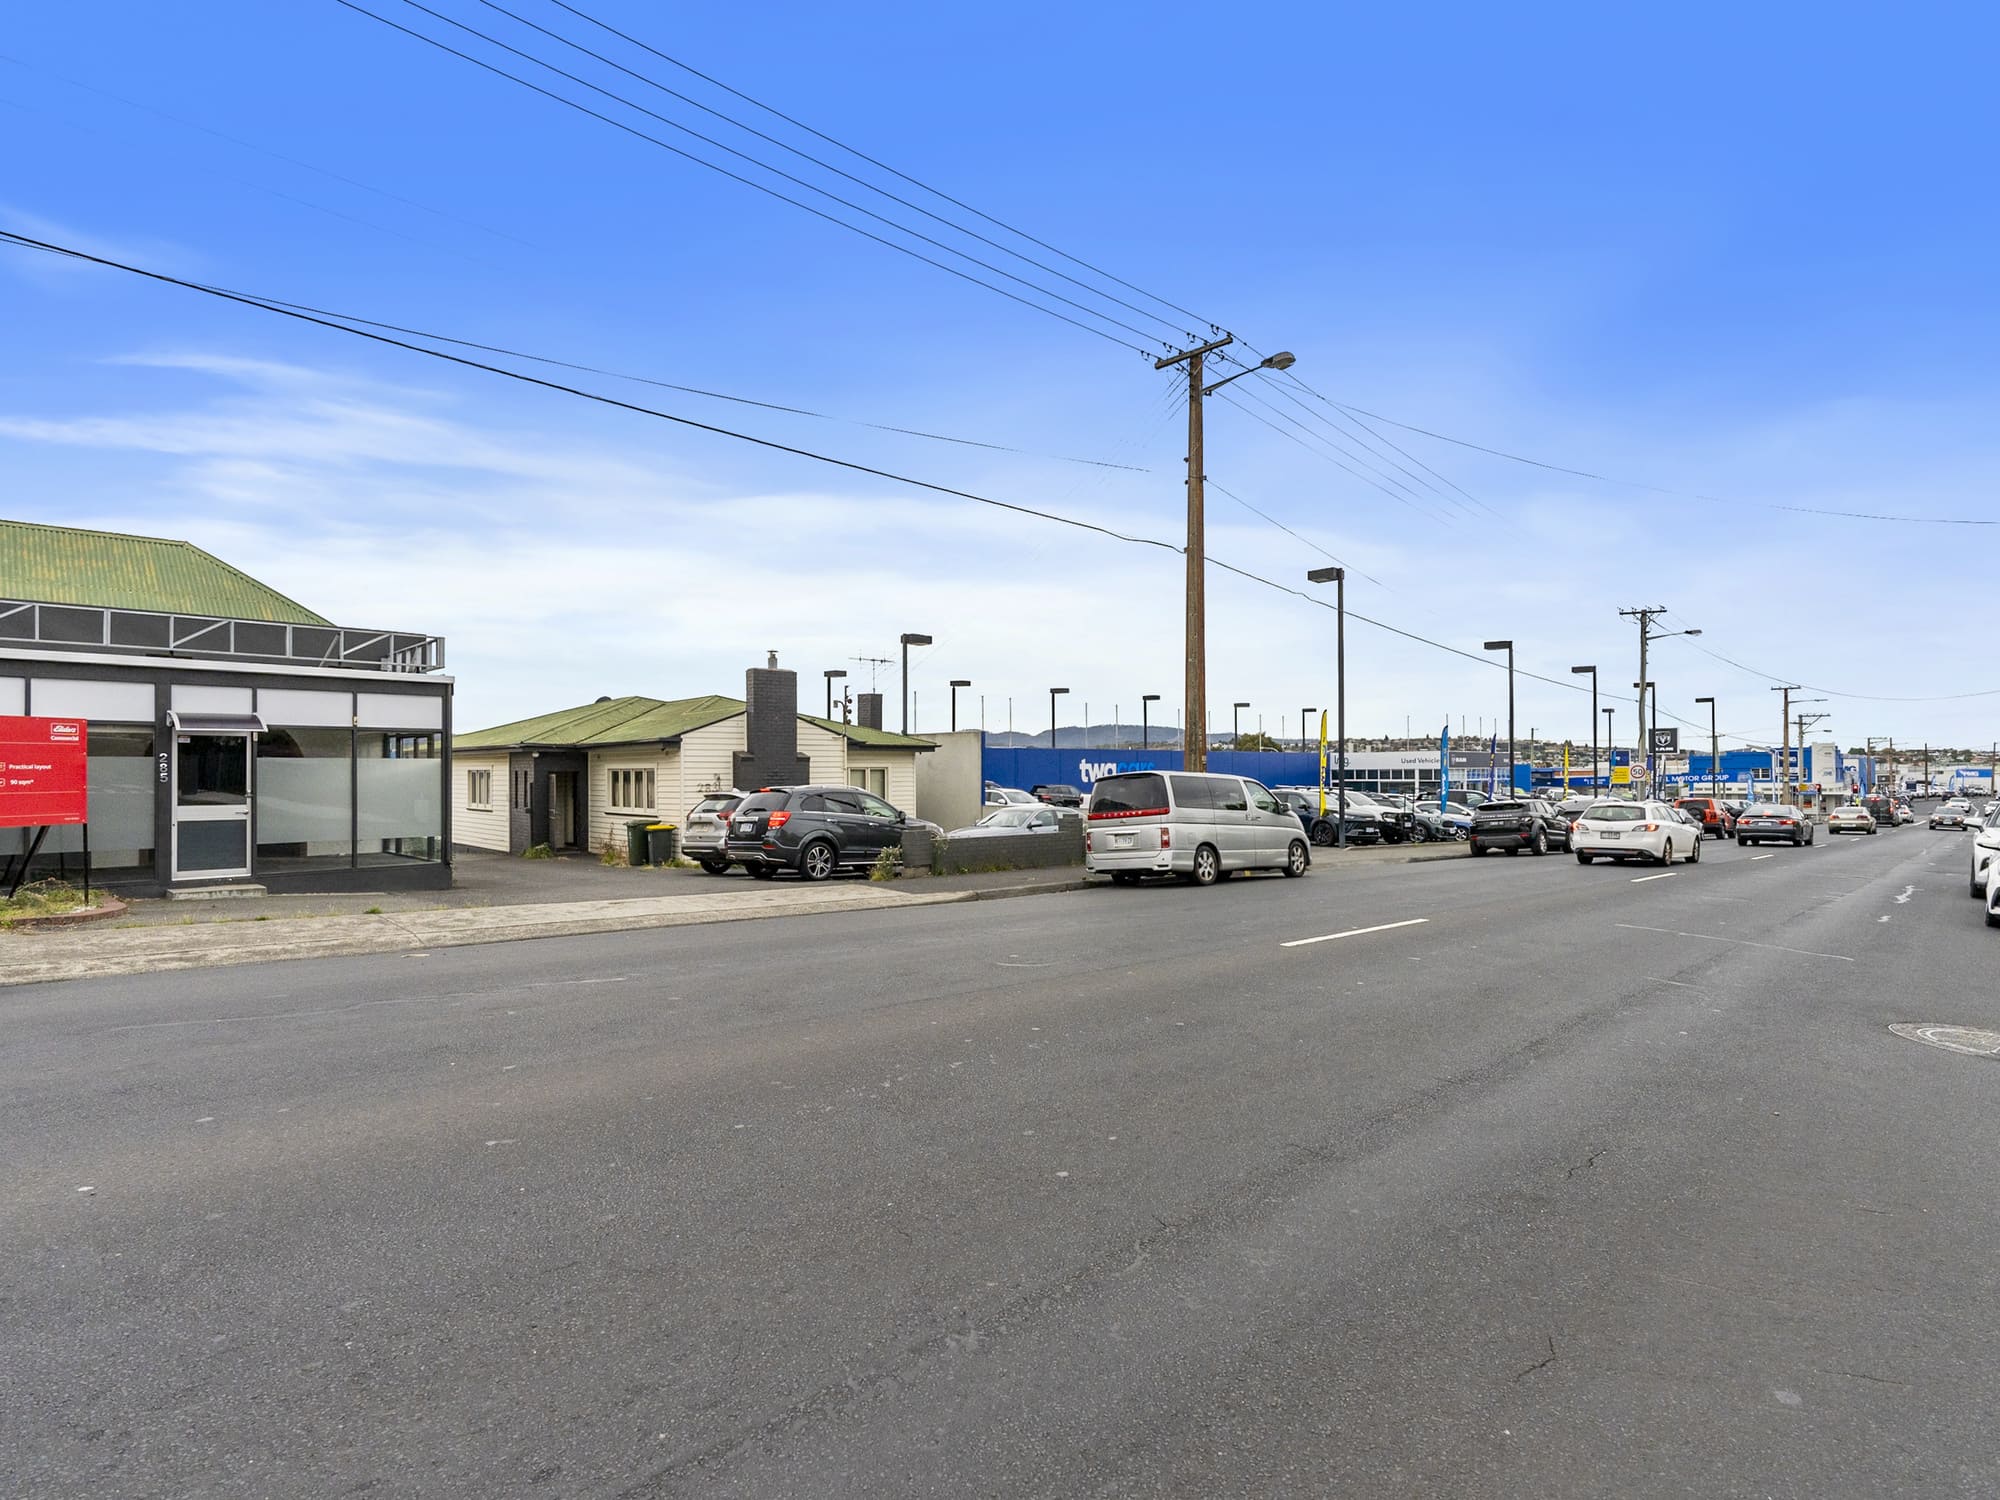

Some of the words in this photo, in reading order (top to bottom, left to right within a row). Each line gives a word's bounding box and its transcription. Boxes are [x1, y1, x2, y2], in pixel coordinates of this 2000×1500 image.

[35, 763, 52, 771] layout
[159, 752, 169, 783] 285
[1632, 768, 1643, 776] 50
[1671, 774, 1700, 782] MOTOR
[1701, 774, 1730, 782] GROUP
